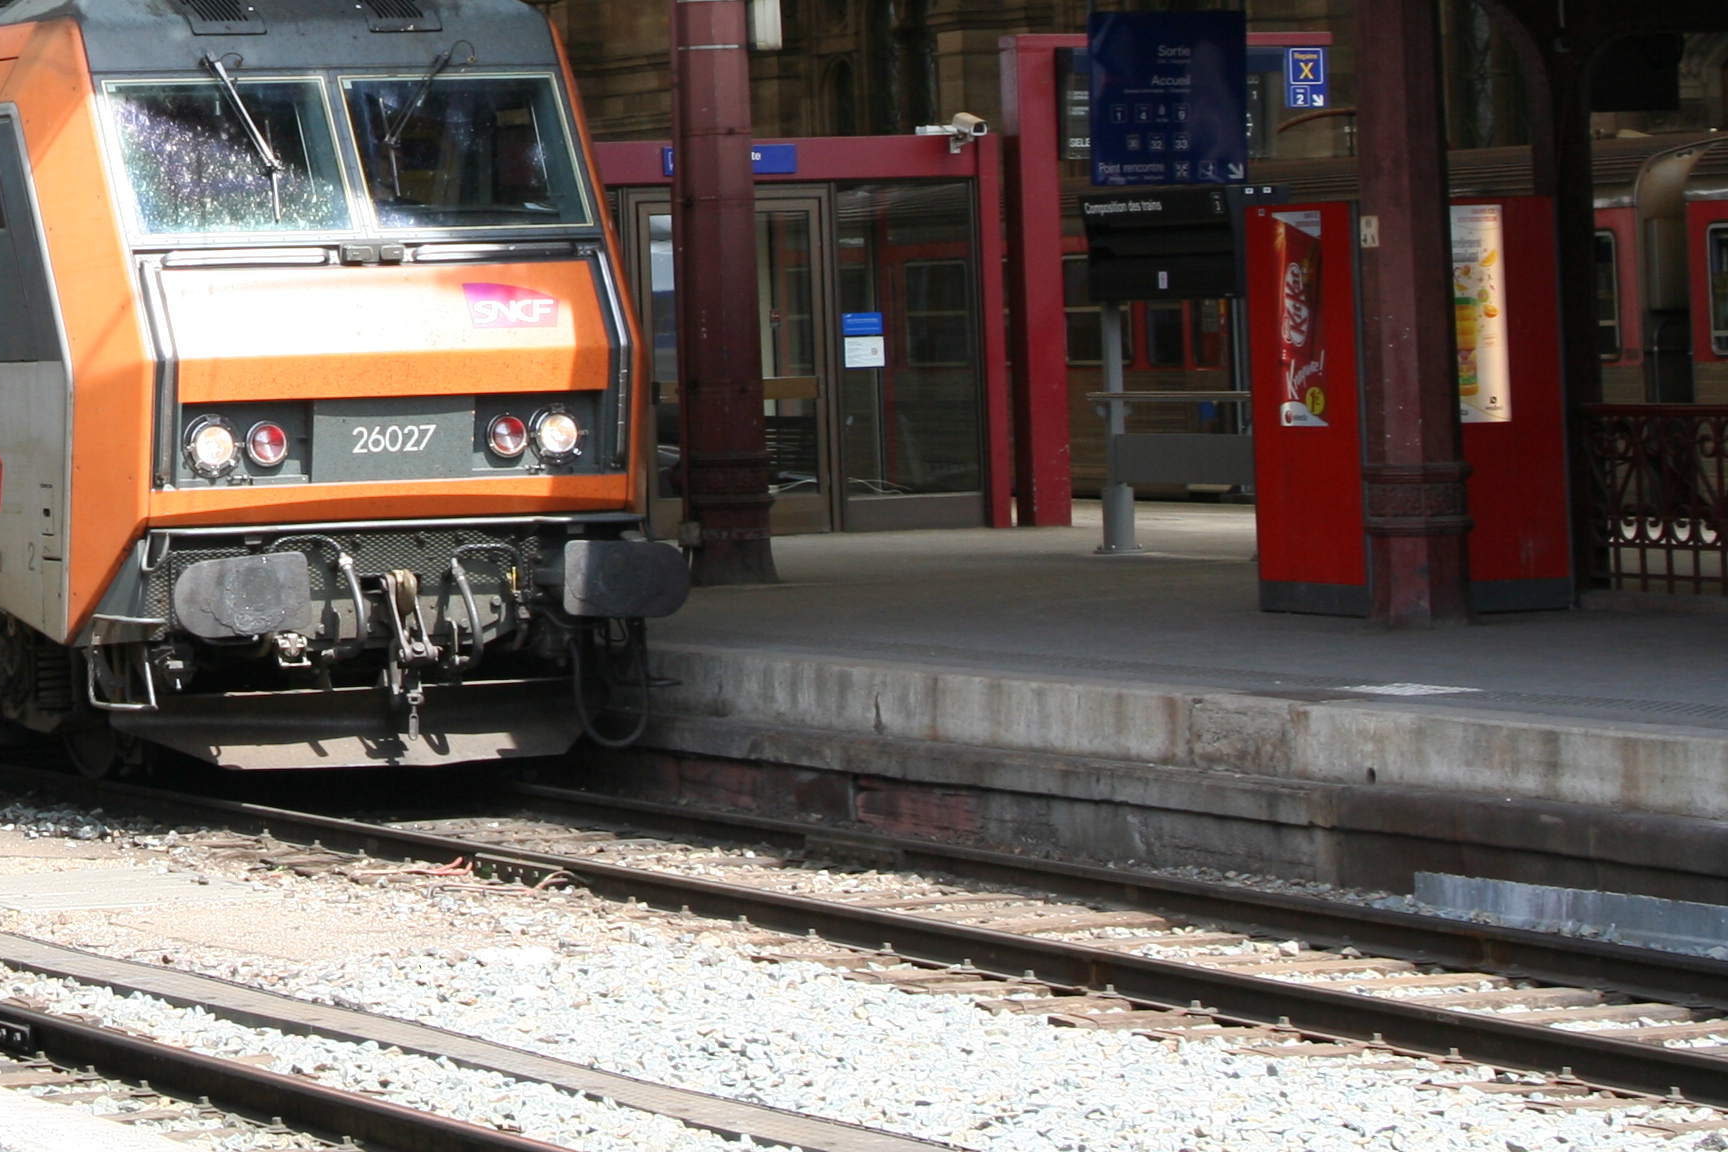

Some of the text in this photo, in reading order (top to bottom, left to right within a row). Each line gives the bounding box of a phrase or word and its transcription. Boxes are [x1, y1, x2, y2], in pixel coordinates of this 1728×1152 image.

[1157, 44, 1191, 57] Sortie
[1299, 62, 1314, 80] X
[1151, 74, 1191, 86] Accueil
[1296, 94, 1305, 105] 2
[1116, 111, 1122, 121] 1
[1140, 111, 1147, 120] 4
[1177, 110, 1185, 120] 9
[1150, 140, 1162, 150] 32
[1174, 139, 1189, 149] 33
[1098, 161, 1165, 174] Point rencontre
[1084, 200, 1127, 216] Composition
[1127, 200, 1141, 212] des
[1141, 198, 1163, 212] trains
[473, 298, 555, 325] SNCF
[351, 423, 437, 455] 26027
[27, 541, 36, 572] 2
